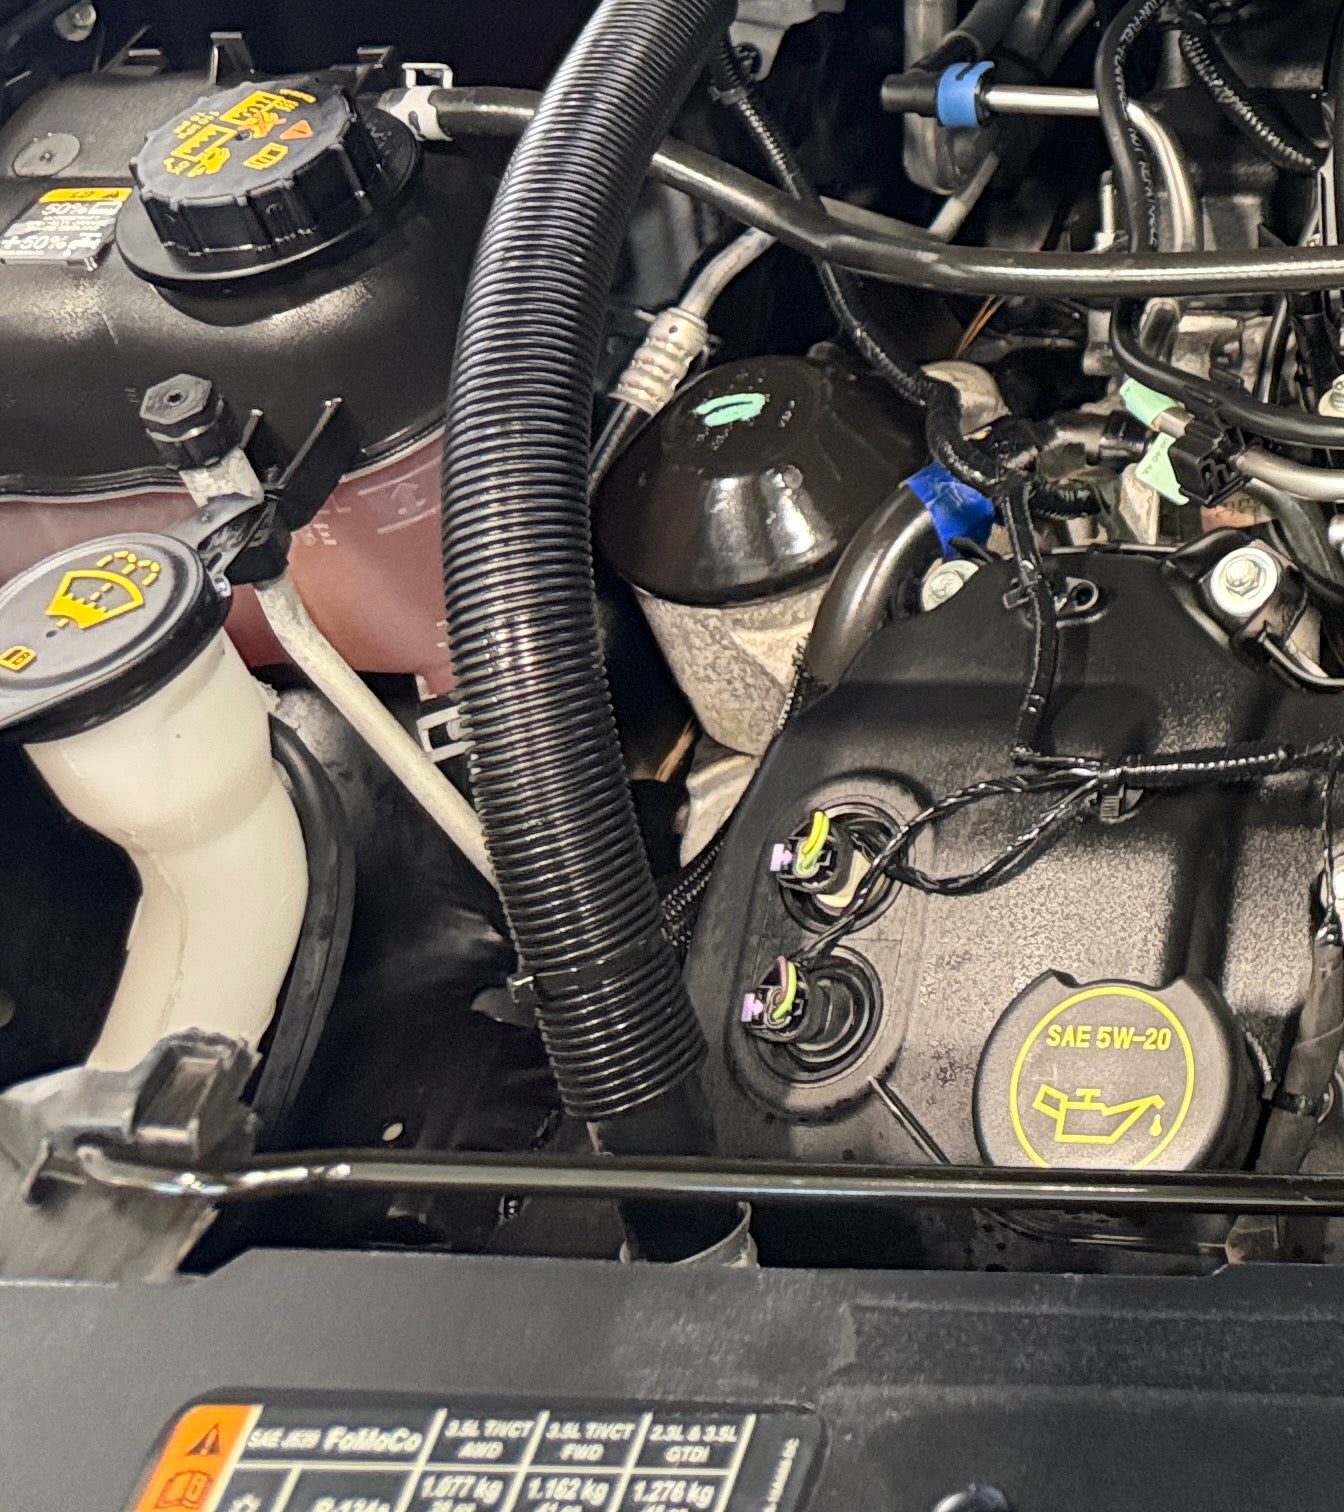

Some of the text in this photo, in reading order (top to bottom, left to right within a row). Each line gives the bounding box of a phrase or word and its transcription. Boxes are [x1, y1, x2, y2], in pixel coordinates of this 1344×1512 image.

[1046, 1024, 1172, 1051] SAE 5W-20
[323, 1425, 424, 1454] FoMoCo
[545, 1421, 584, 1440] 3.5L
[559, 1443, 605, 1463] FWD
[476, 1477, 504, 1505] kg
[580, 1479, 611, 1507] kg
[686, 1480, 716, 1508] kg
